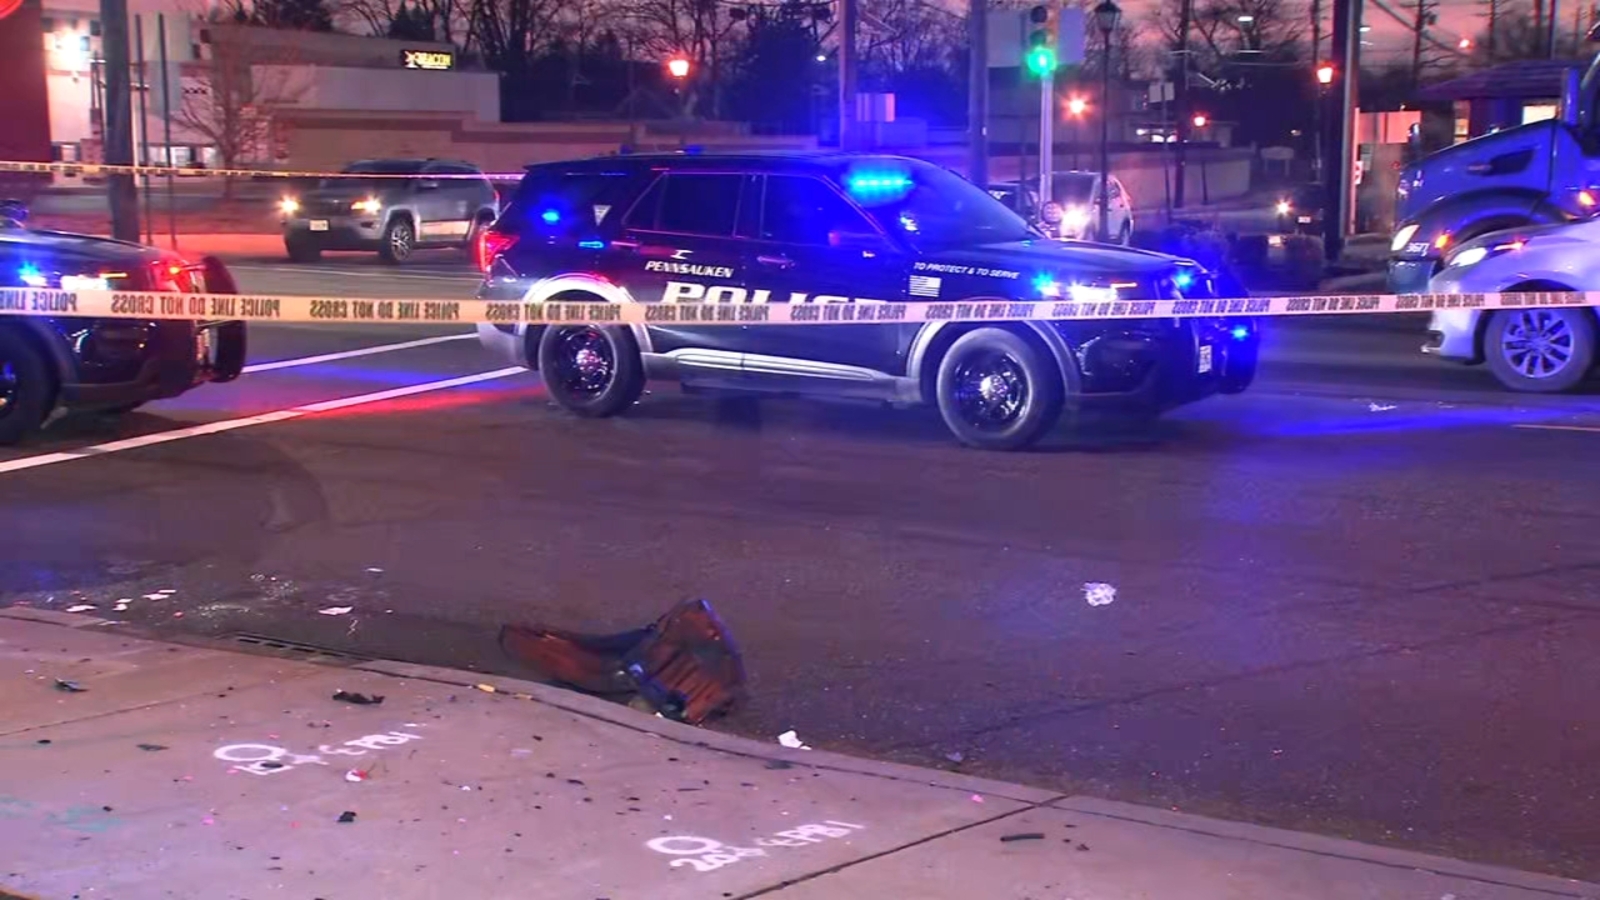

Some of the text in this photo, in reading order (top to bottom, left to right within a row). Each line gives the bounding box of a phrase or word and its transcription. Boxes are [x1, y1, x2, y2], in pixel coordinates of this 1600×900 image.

[645, 260, 735, 278] PENNSAUKEN
[914, 262, 1020, 279] TO PROTECT & TO SERVE
